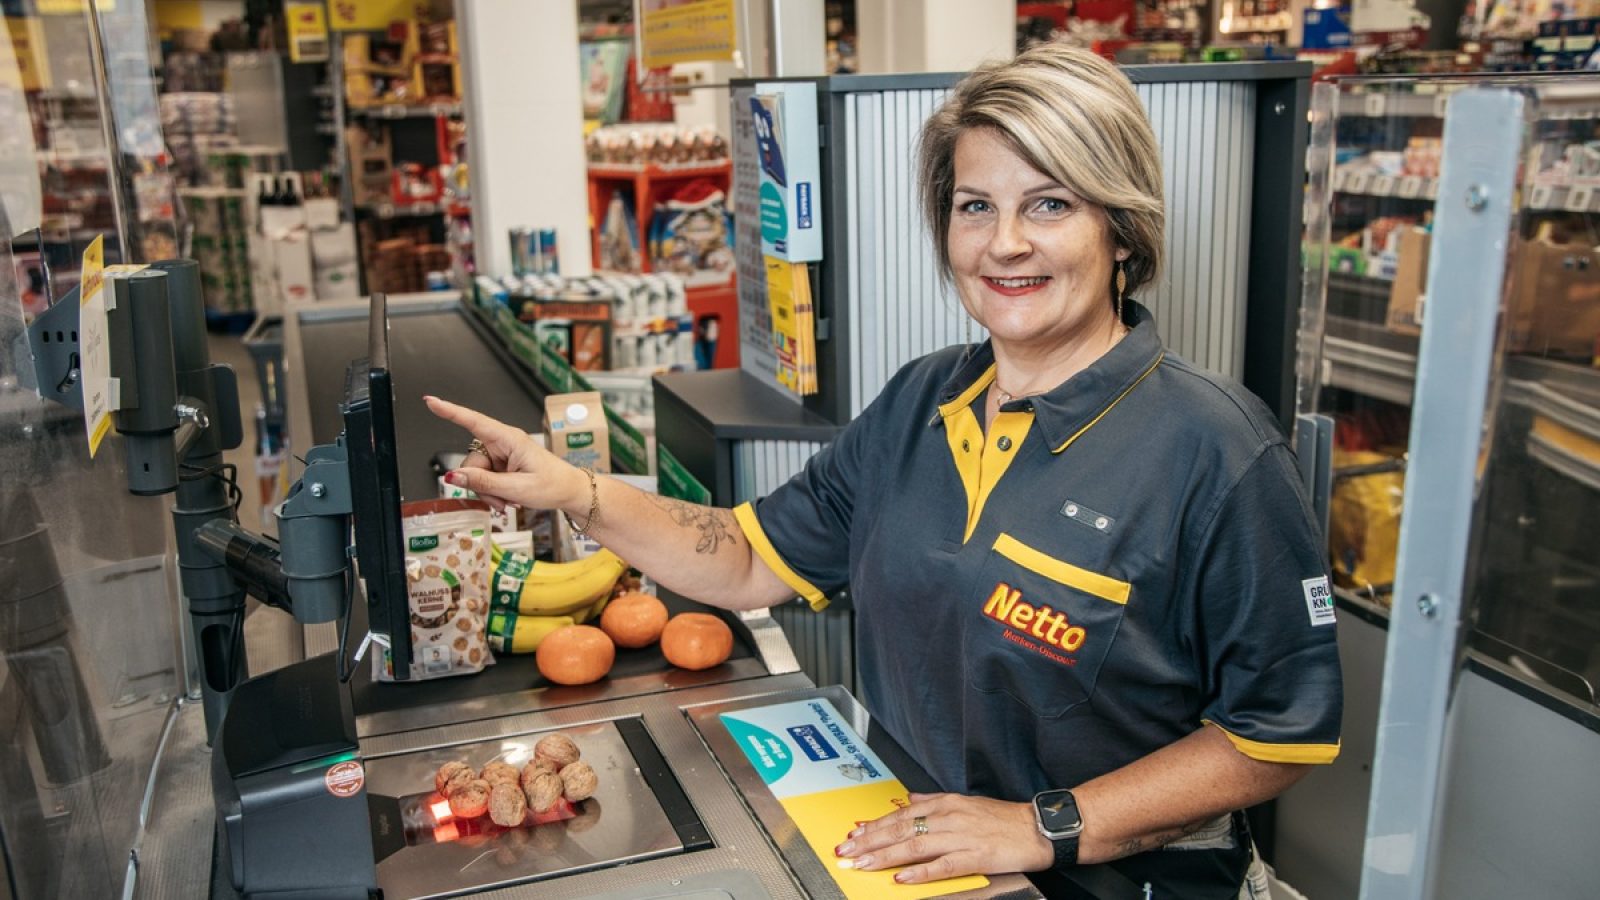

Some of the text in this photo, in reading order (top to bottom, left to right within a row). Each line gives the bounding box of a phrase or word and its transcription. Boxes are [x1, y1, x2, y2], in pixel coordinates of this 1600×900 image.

[412, 537, 436, 547] BioBio
[411, 588, 449, 598] WALNUSS
[418, 596, 443, 604] KERNE
[983, 583, 1086, 652] Netto
[1003, 629, 1076, 666] Marken-Discount
[826, 722, 852, 745] PAYBACK
[803, 734, 829, 759] PAYBACK
